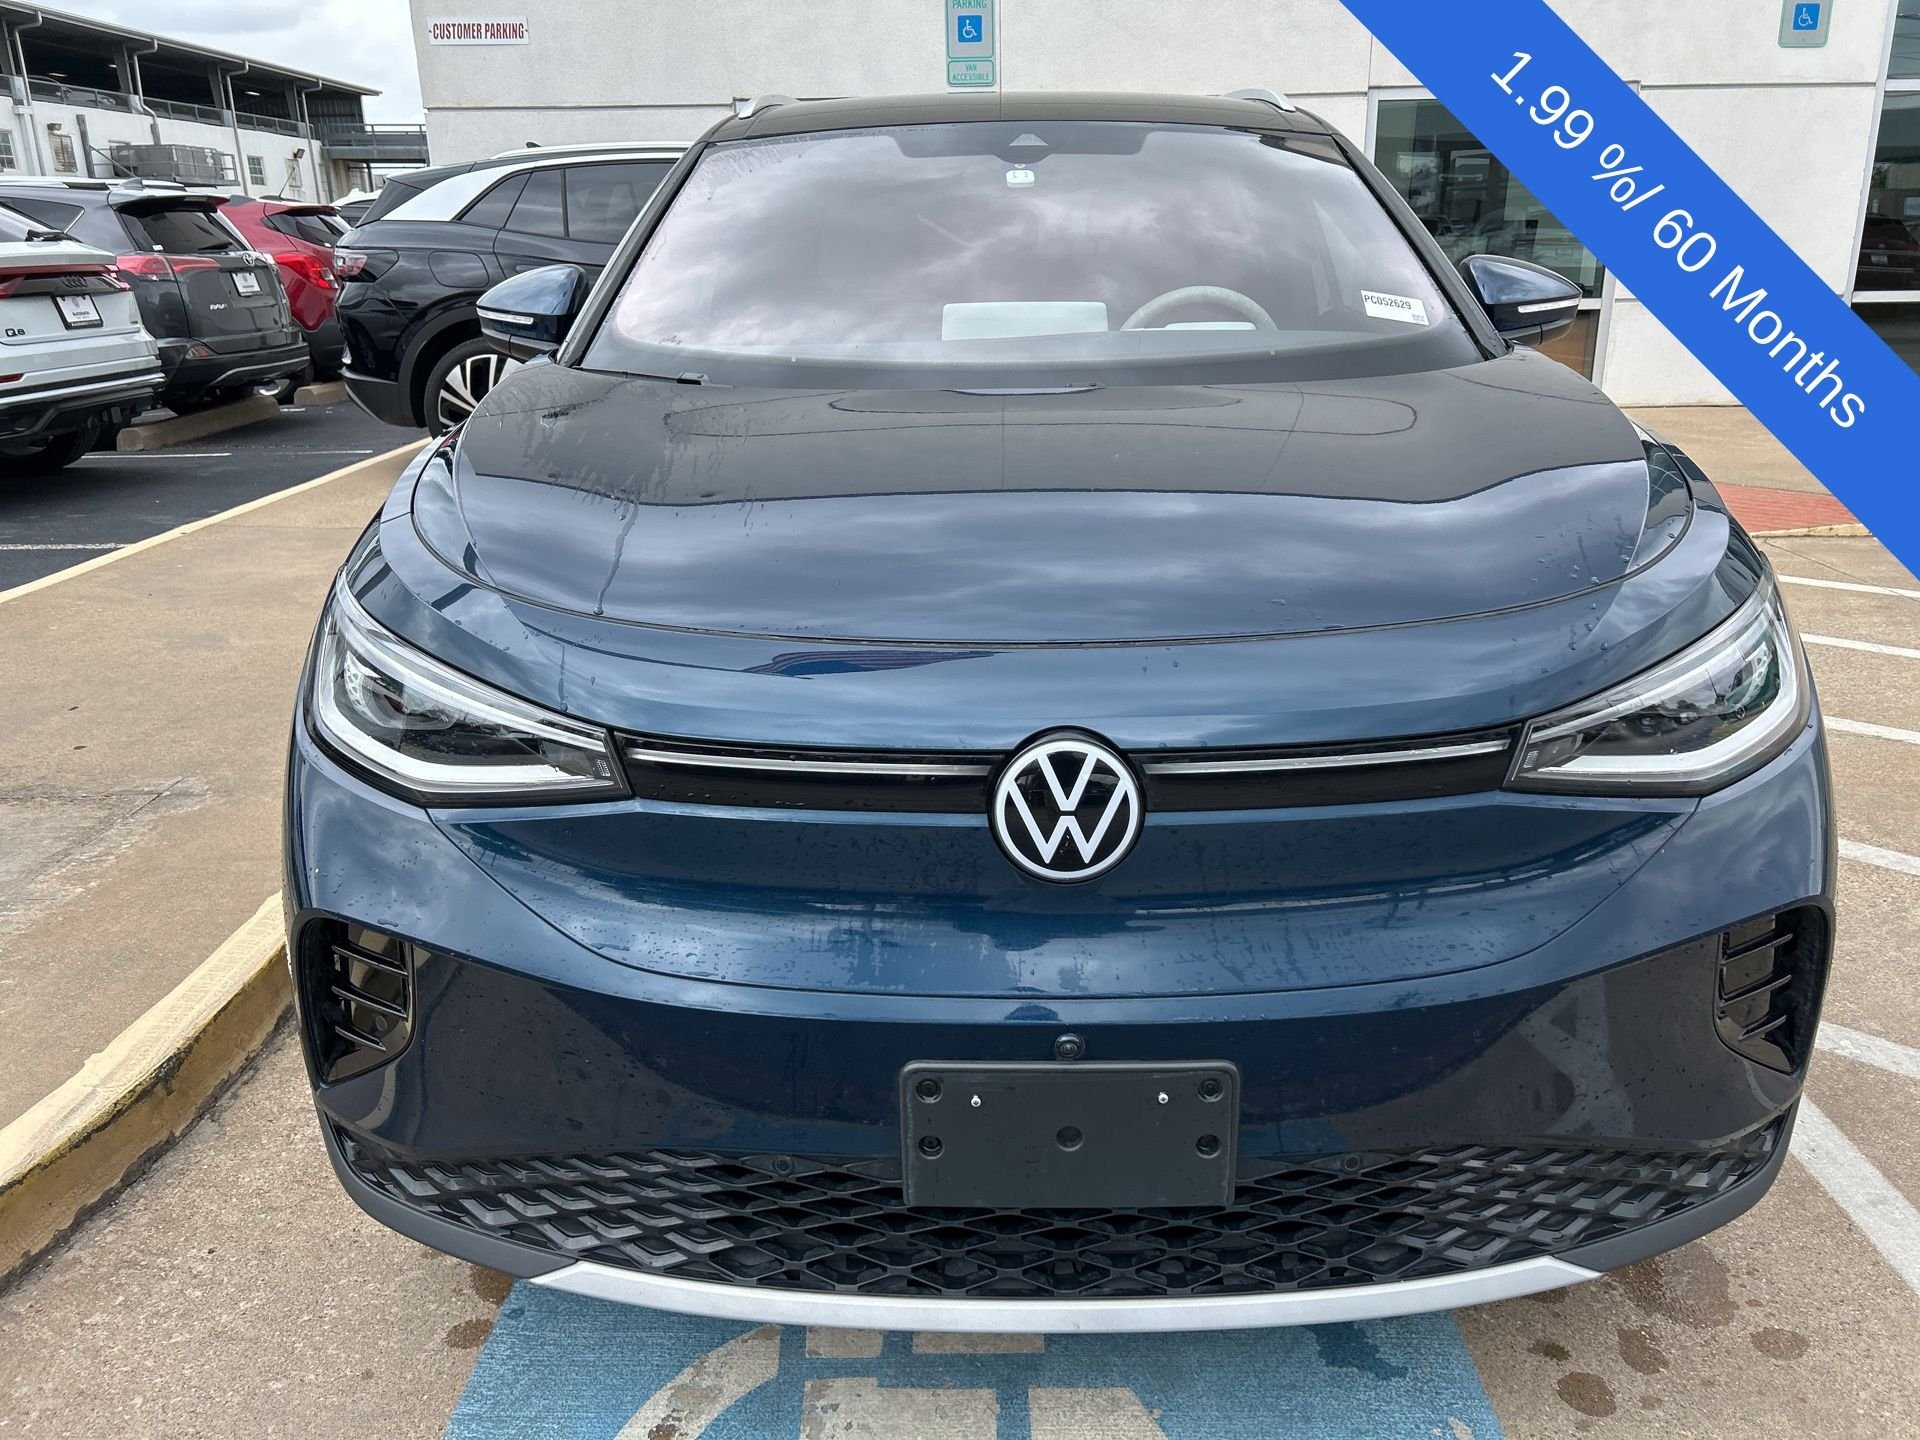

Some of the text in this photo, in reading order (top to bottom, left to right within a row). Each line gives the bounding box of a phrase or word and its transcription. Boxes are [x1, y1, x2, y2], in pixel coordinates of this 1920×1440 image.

[952, 0, 987, 9] PARKING
[433, 23, 524, 39] CUSTOMER PARKING
[965, 63, 977, 71] VAN
[952, 73, 990, 81] ACCESSIBLE
[1363, 294, 1412, 310] PC052629
[5, 328, 26, 337] Q8
